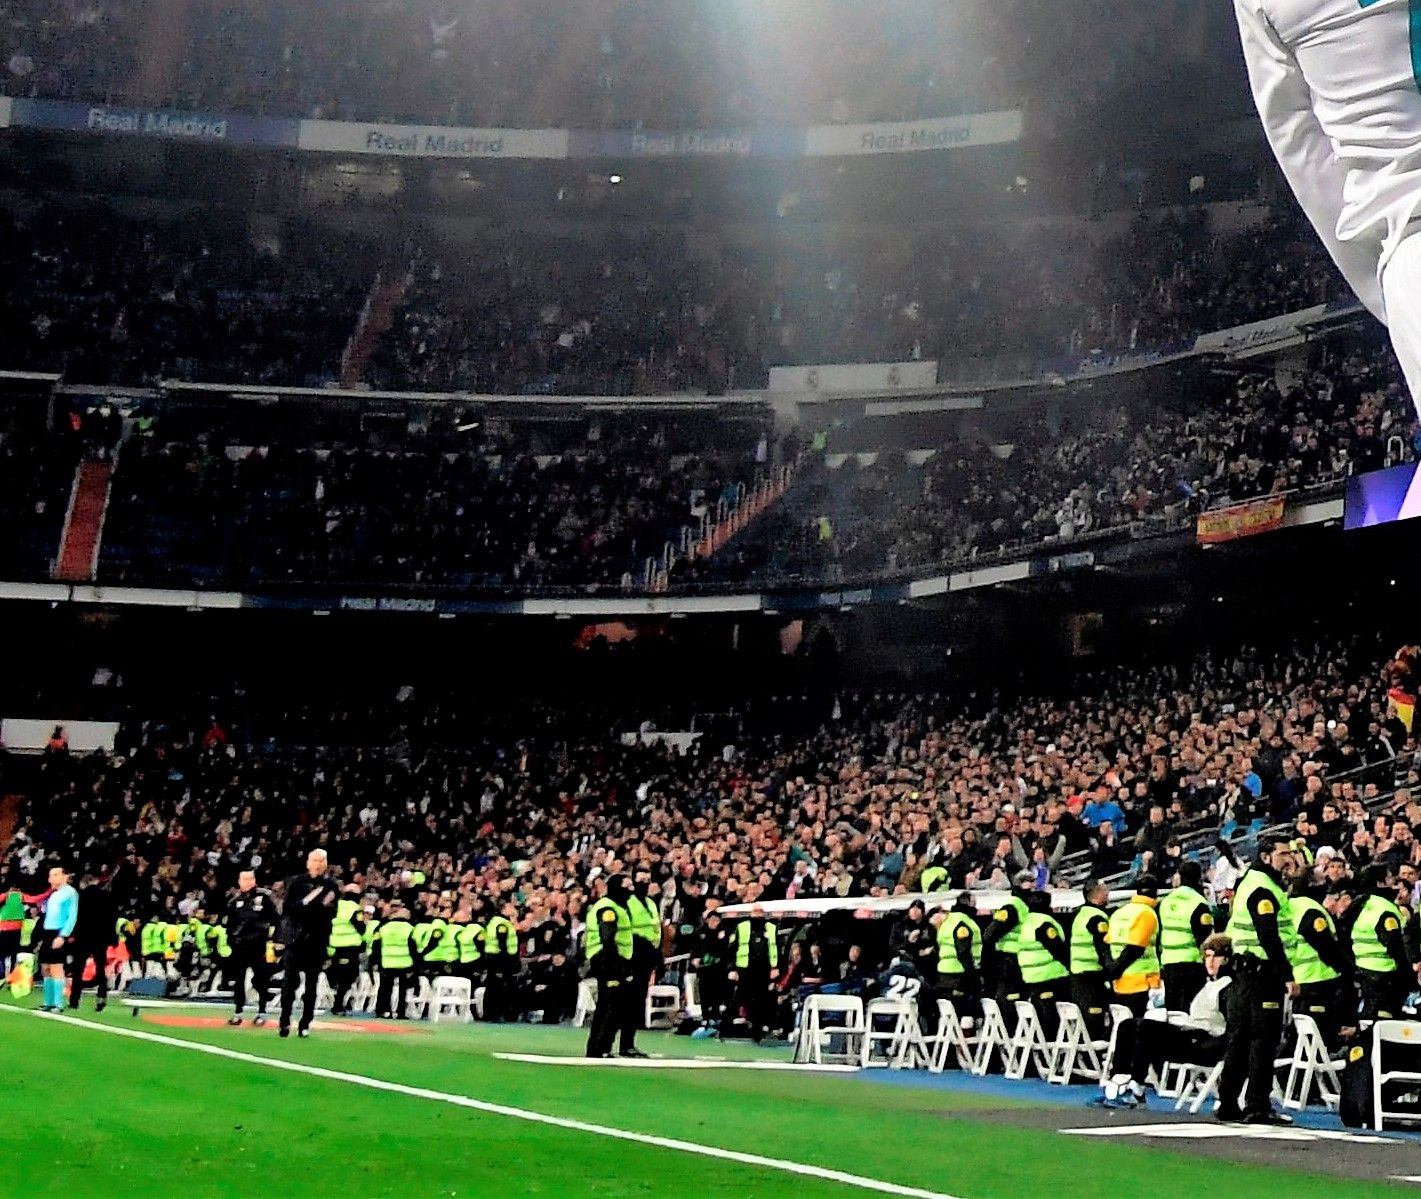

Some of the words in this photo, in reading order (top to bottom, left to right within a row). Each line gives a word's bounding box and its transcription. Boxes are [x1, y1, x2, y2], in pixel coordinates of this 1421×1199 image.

[367, 131, 418, 151] Real
[425, 135, 503, 153] Madrid
[886, 974, 921, 1003] 22
